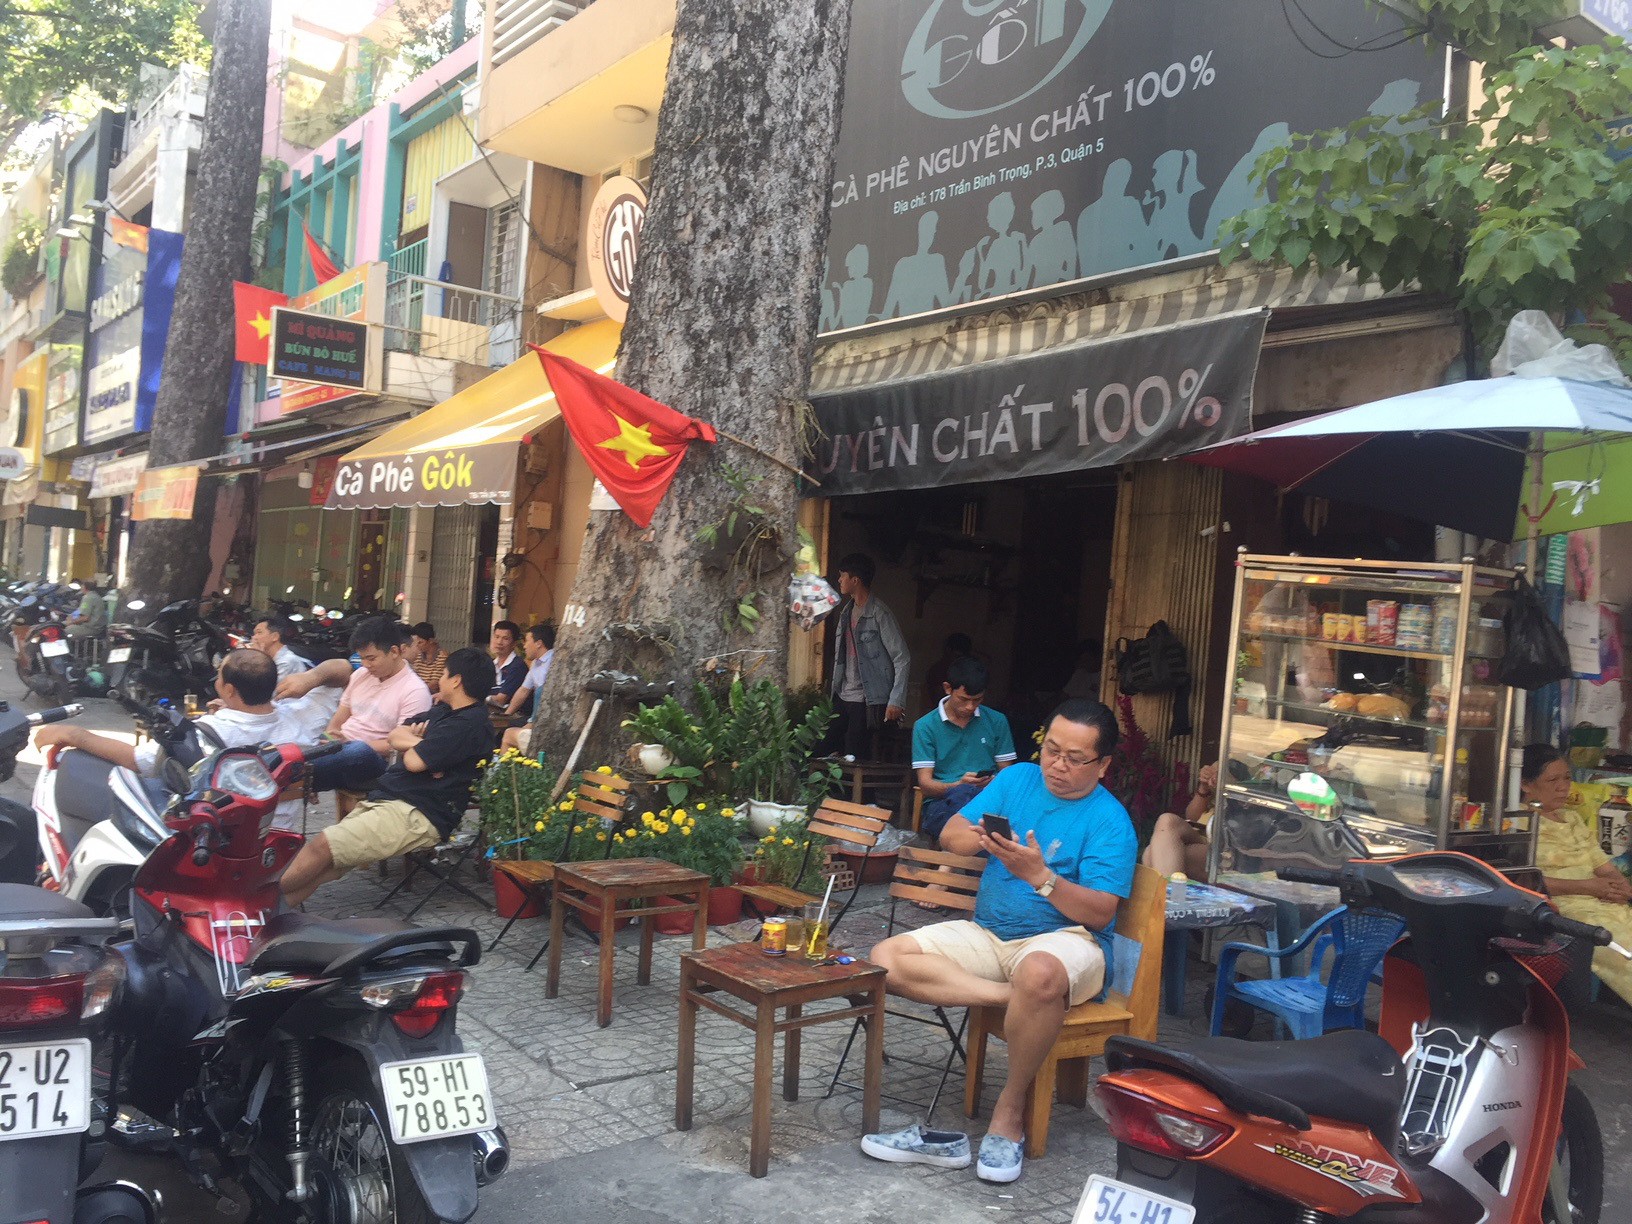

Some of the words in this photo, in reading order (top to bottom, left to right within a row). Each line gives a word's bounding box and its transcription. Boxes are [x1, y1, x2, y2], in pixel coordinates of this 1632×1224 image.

[831, 174, 859, 207] CÀ
[865, 155, 911, 198] PHÊ
[917, 123, 1022, 181] NGUYÊN
[1029, 84, 1113, 143] CHẤT
[1124, 50, 1216, 112] 100%
[929, 187, 947, 203] 178
[999, 162, 1033, 183] Trọng,
[1035, 153, 1058, 173] P.3,
[1060, 143, 1093, 164] Quận
[1096, 138, 1104, 153] 5
[821, 415, 919, 474] UYÊN
[932, 383, 1054, 464] CHẤT
[1071, 363, 1222, 447] 100%
[335, 461, 364, 496] Cà
[369, 455, 415, 493] Phê
[421, 450, 475, 491] Gôk
[0, 1050, 70, 1088] 2-U2
[398, 1060, 469, 1098] 59-H1
[0, 1090, 69, 1132] 514
[396, 1094, 488, 1137] 788.53
[1482, 1100, 1523, 1112] HONDA
